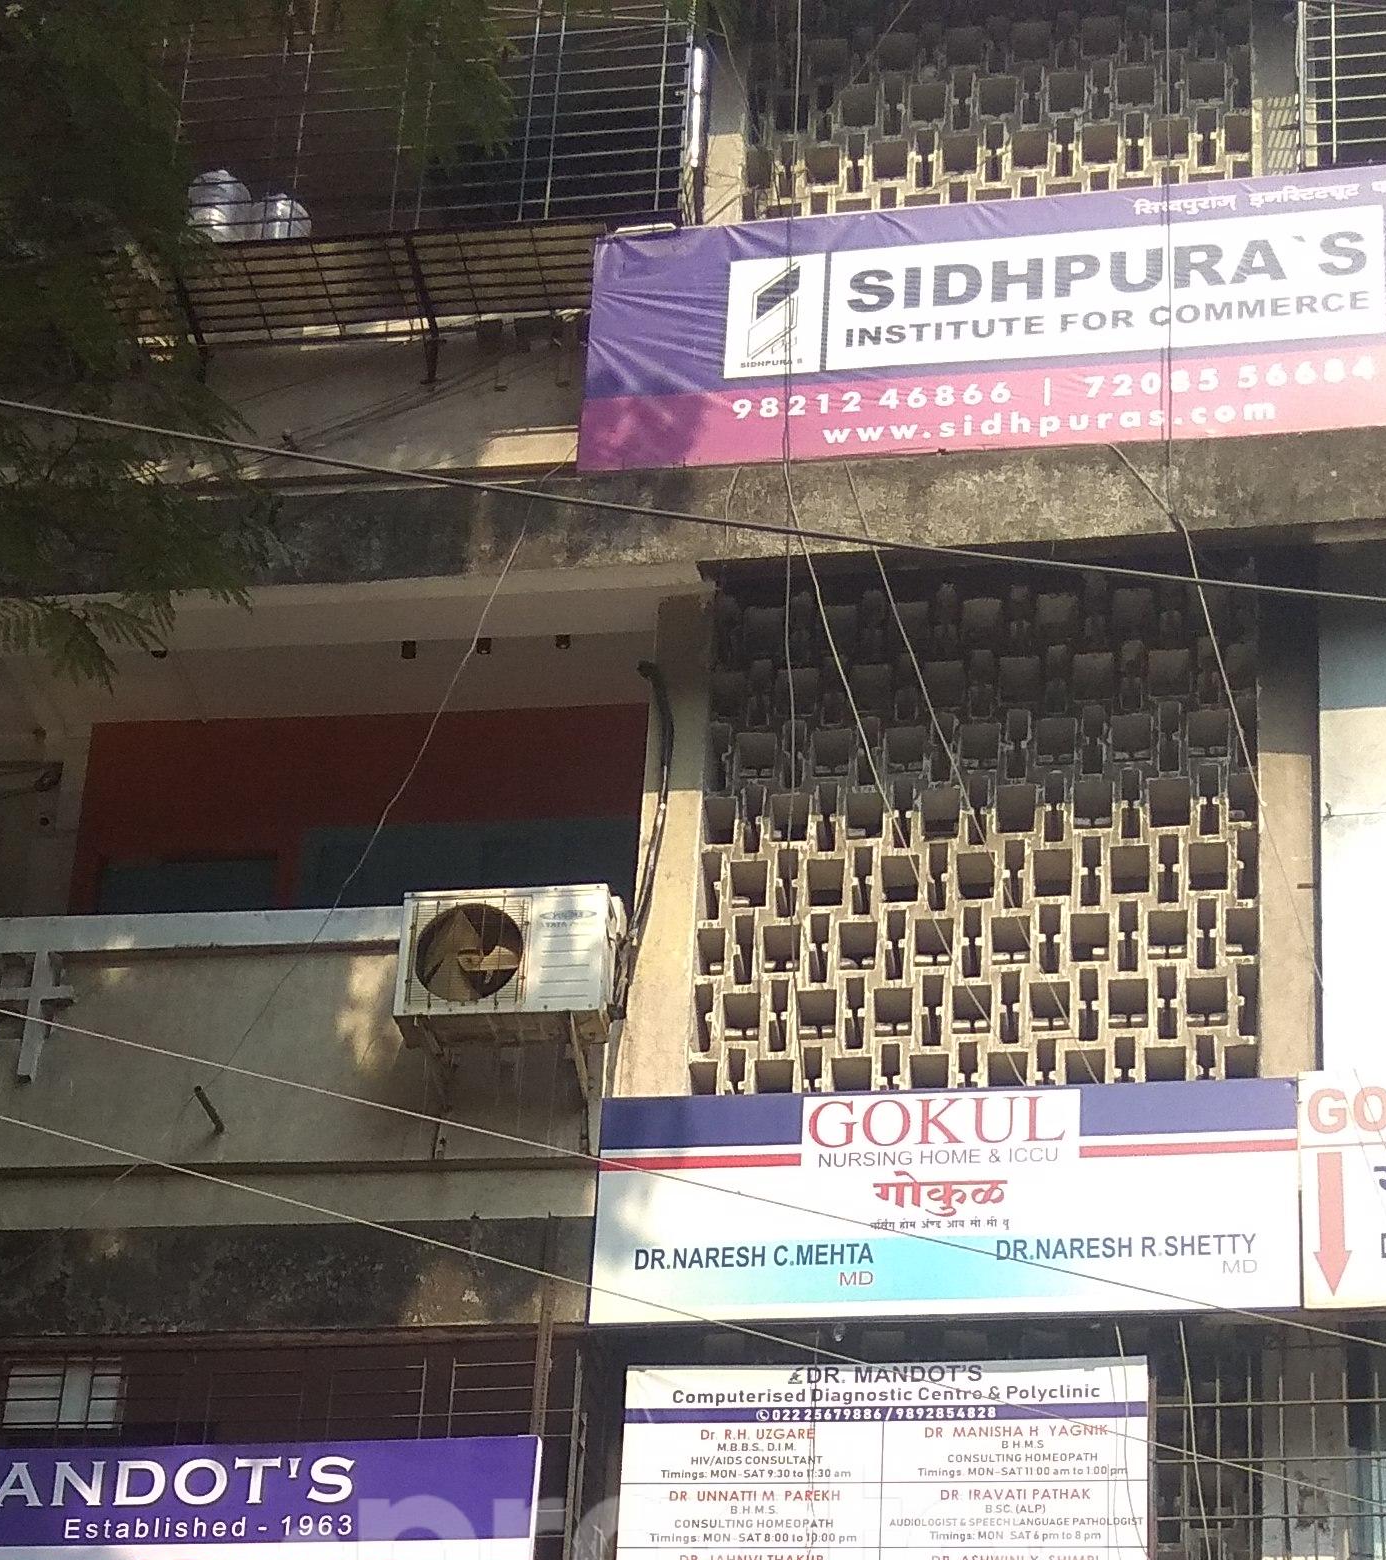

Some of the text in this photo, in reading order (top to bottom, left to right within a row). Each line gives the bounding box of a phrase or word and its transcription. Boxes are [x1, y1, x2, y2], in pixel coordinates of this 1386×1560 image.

[846, 289, 1370, 349] INSTITUTE FOR COMMERCE
[732, 391, 862, 420] 98212
[879, 382, 1012, 411] 46866
[822, 401, 1276, 446] www.sidhpuras.com
[808, 1096, 1065, 1147] GOKUL
[818, 1147, 1058, 1167] NURSING HOME & ICCU
[873, 1170, 1007, 1217] गोकुळ
[634, 1243, 873, 1270] DR.NARESH C.MEHTA
[996, 1237, 1133, 1261] DR.NARESH
[1223, 1258, 1258, 1273] MD
[840, 1271, 873, 1287] MD
[854, 1364, 983, 1384] MANDOT'S
[673, 1385, 1101, 1405] Computerised Diagnostic Centre Polyclinic
[756, 1429, 815, 1439] UZGARE
[953, 1426, 1023, 1438] MANISHA
[691, 1455, 822, 1465] HIV/AIDS CONSULTANT
[1032, 1489, 1090, 1499] PATHAK
[64, 1515, 352, 1540] Established 1963
